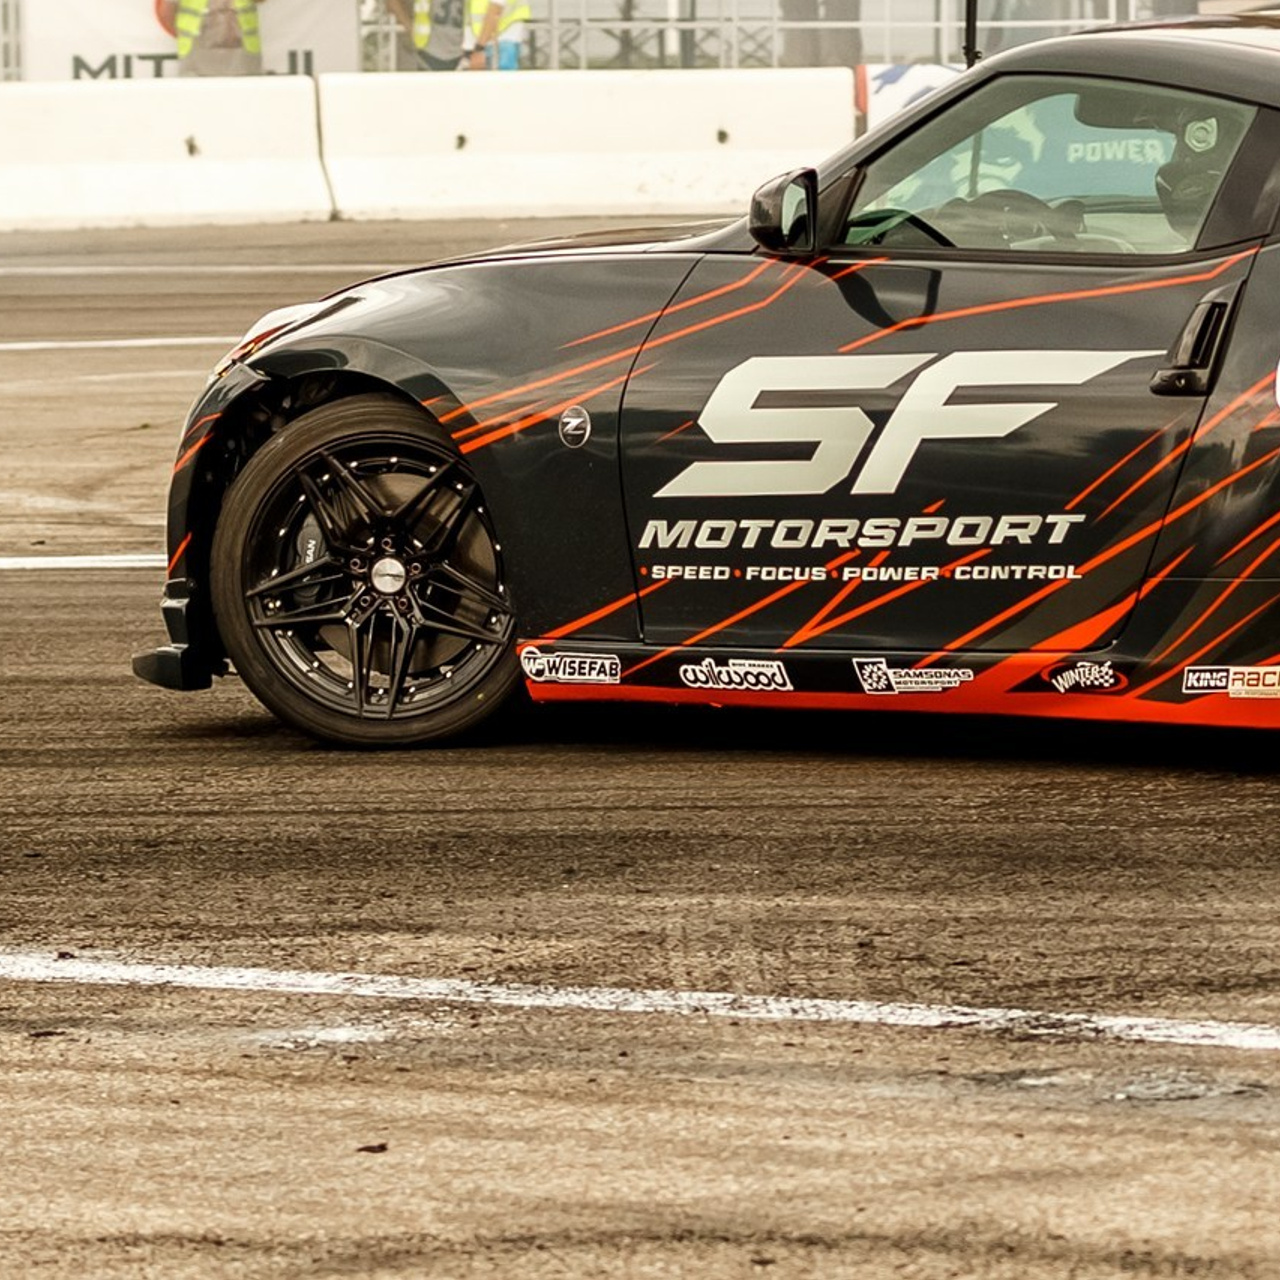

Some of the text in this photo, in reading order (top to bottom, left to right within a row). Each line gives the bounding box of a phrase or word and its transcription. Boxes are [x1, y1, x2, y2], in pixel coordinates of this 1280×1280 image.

[1068, 139, 1164, 162] POWER
[652, 350, 1168, 498] SF
[638, 514, 1086, 550] MOTORSPORT
[650, 564, 1083, 582] SPEED FOCUS POWER CONTROL
[546, 658, 620, 677] WISEFAB
[682, 661, 788, 688] wilwood
[893, 670, 972, 679] SAMSONAS
[1186, 671, 1228, 688] KING
